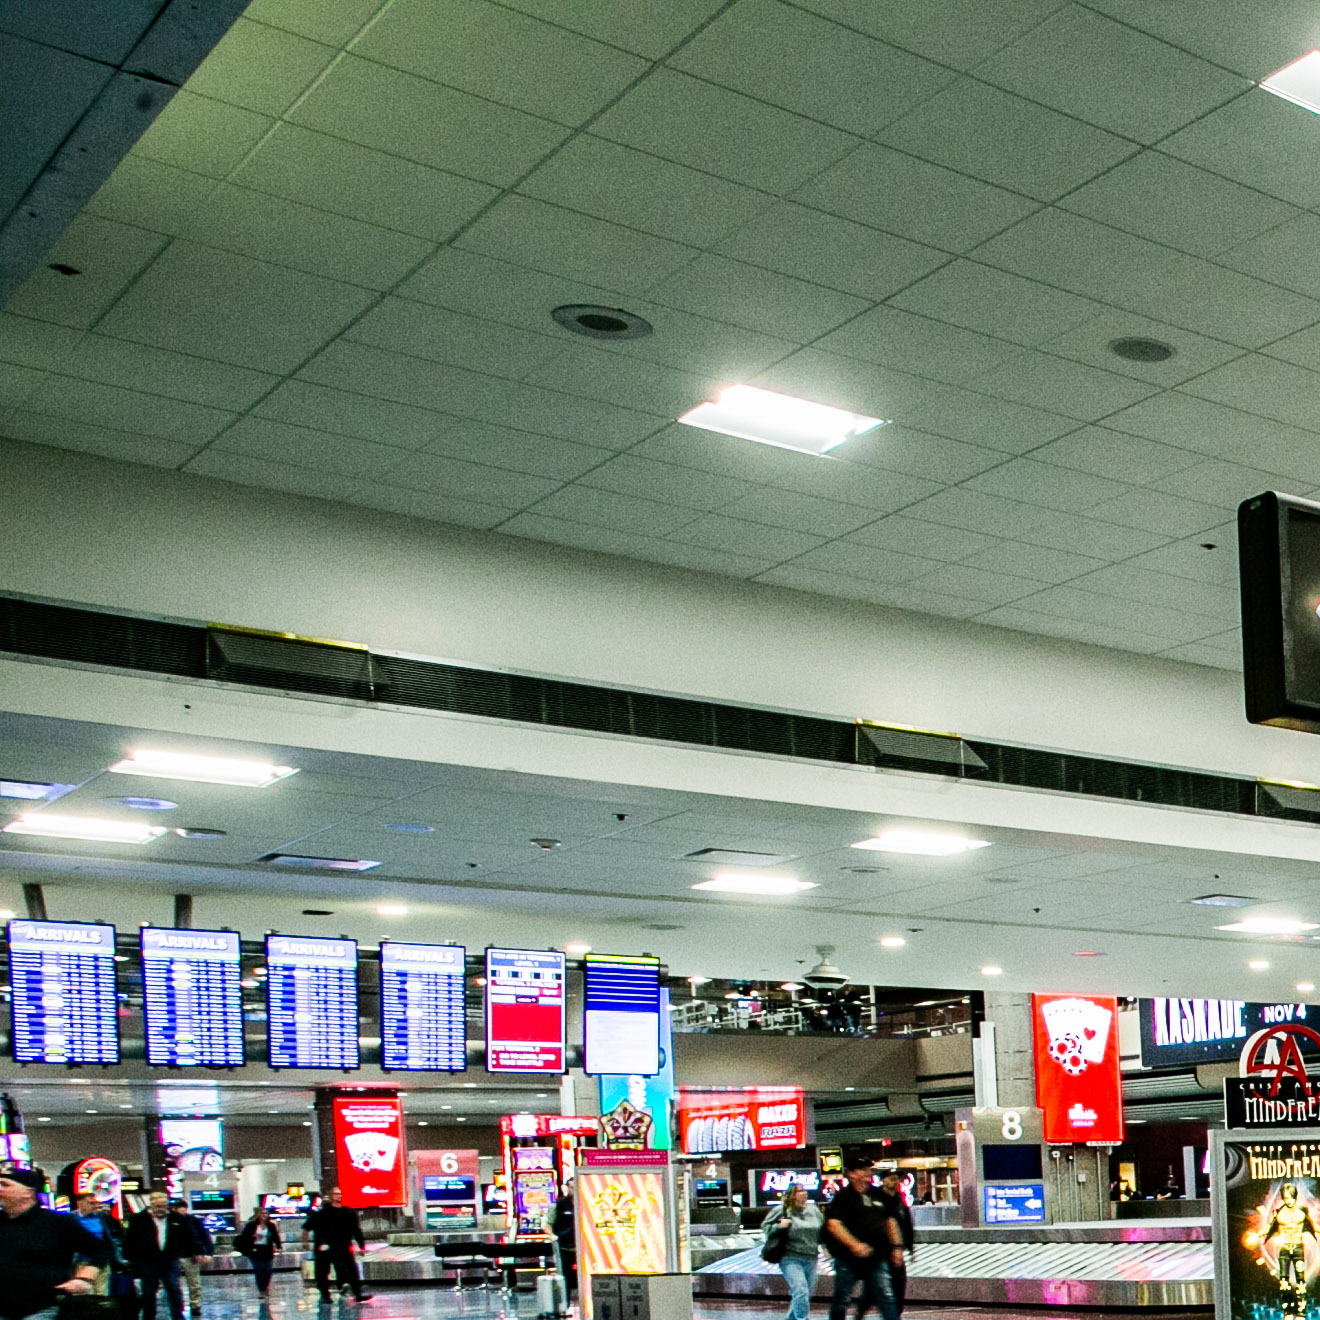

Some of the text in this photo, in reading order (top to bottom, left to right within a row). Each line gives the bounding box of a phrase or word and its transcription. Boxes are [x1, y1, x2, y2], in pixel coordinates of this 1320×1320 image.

[26, 926, 102, 944] ARRIVALS
[157, 933, 228, 950] ARRIVALS
[281, 942, 346, 957] ARRIVALS
[395, 948, 455, 963] ARRIVALS
[1154, 998, 1307, 1046] KASKADE NOV 4
[1240, 1082, 1282, 1090] CRISS
[1002, 1111, 1022, 1140] 8
[440, 1153, 458, 1173] 6
[706, 1165, 717, 1177] 4
[205, 1174, 218, 1187] 4
